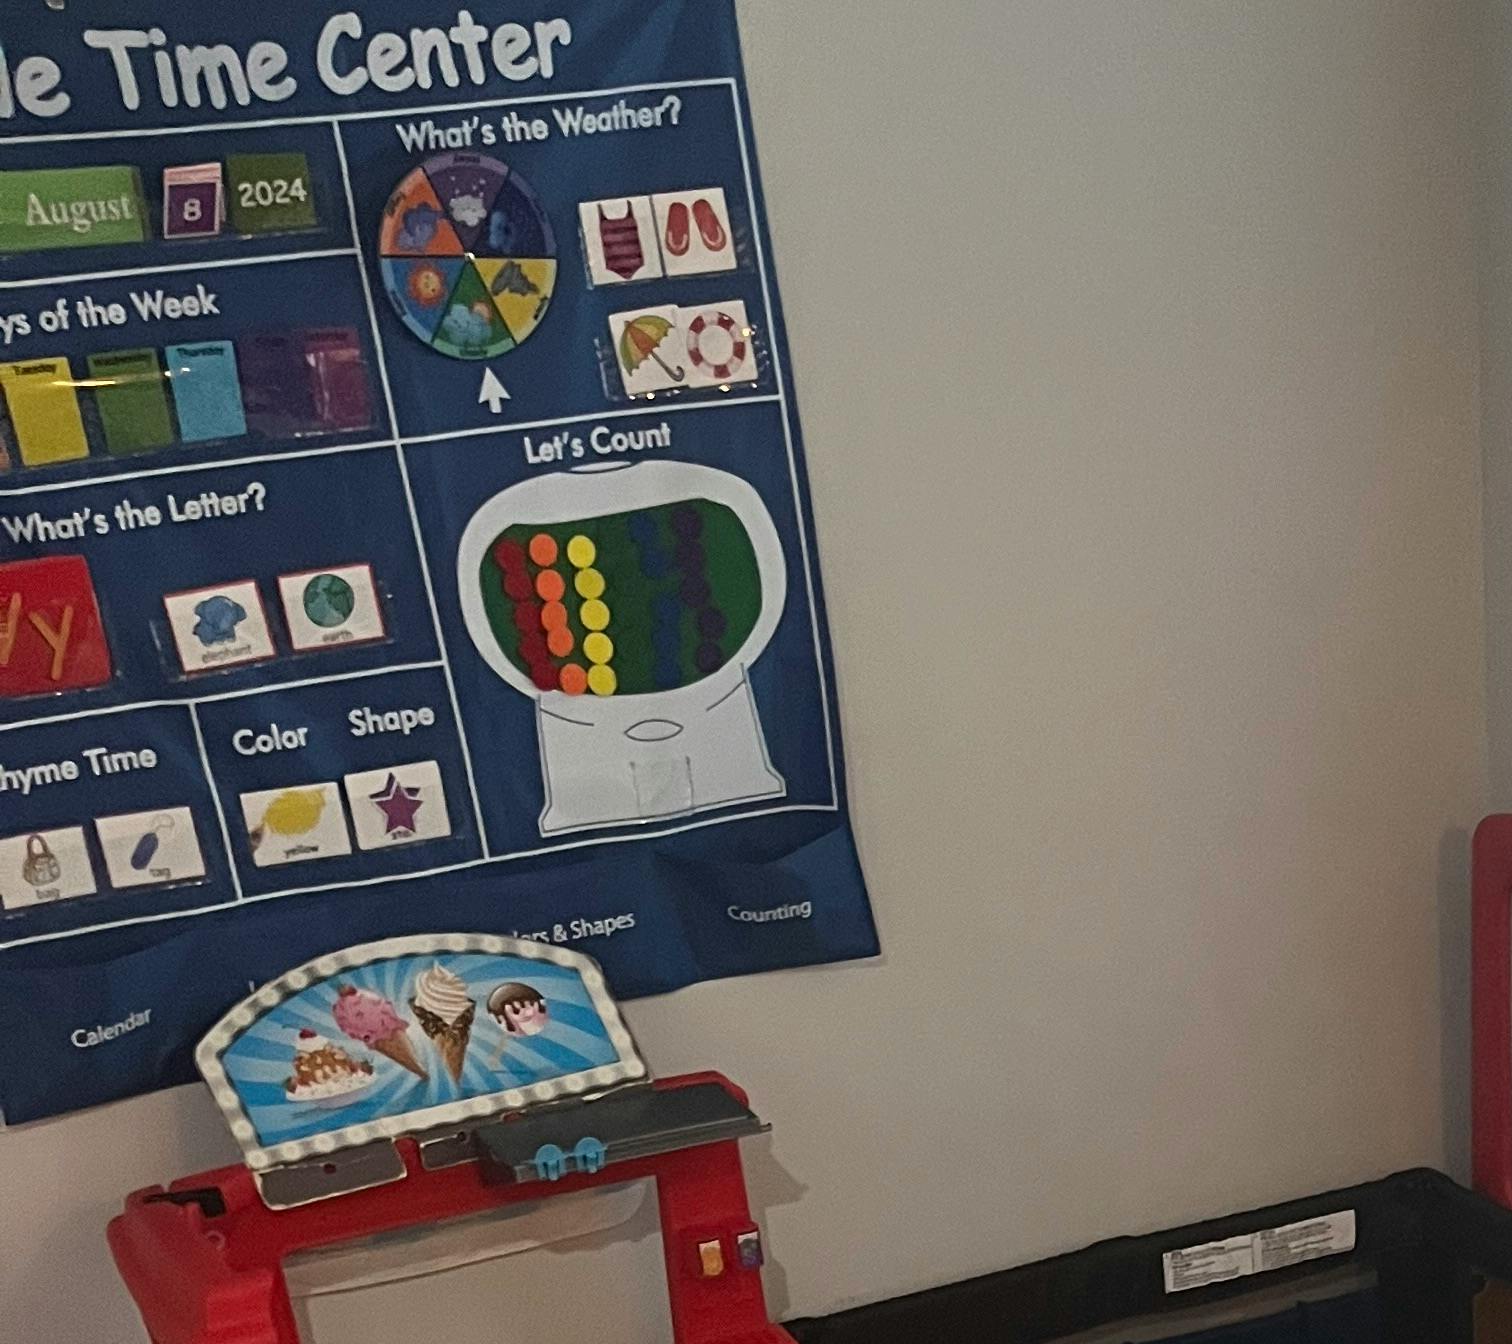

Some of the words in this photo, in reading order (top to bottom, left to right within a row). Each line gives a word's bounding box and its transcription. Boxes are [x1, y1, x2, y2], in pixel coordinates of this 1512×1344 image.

[83, 27, 298, 110] Time
[316, 11, 572, 95] Center
[397, 117, 497, 154] What's
[502, 112, 548, 145] the
[551, 95, 682, 138] Weather?
[26, 193, 135, 233] August
[183, 199, 202, 221] 8
[238, 177, 307, 209] 2024
[39, 299, 71, 333] of
[75, 294, 127, 328] the
[129, 284, 220, 321] Week
[524, 431, 585, 465] Let's
[590, 422, 673, 455] Count
[2, 506, 108, 545] What's
[115, 498, 162, 531] the
[168, 482, 268, 524] Letter?
[232, 724, 310, 758] Color
[348, 704, 436, 740] Shape
[84, 746, 158, 779] Time
[553, 924, 568, 943] &
[571, 913, 636, 941] Shapes
[727, 901, 812, 923] Counting
[71, 1006, 152, 1051] Calendar
